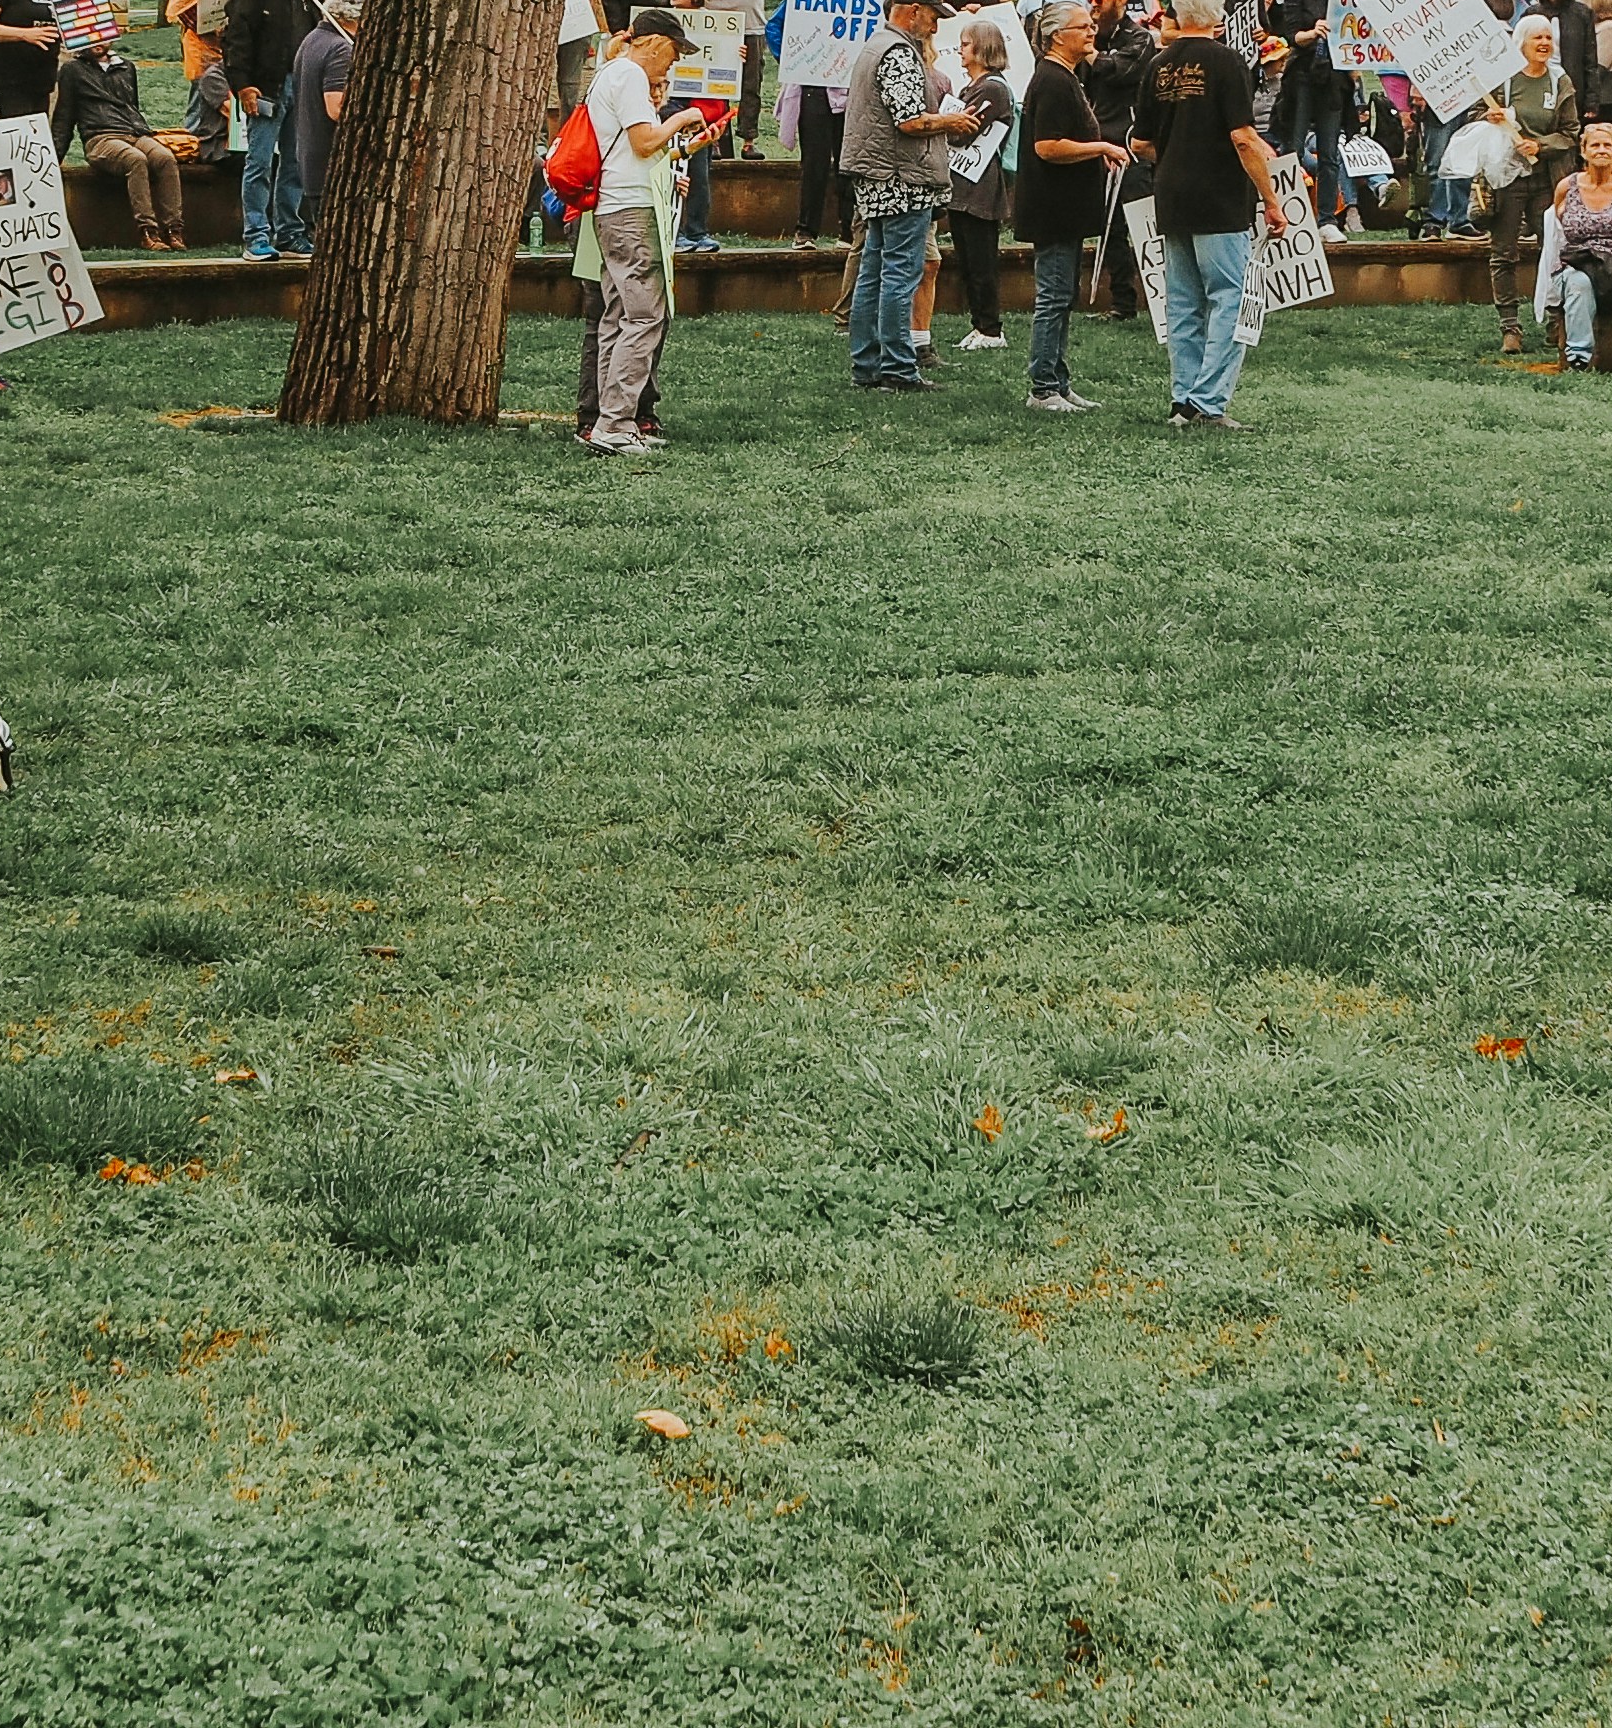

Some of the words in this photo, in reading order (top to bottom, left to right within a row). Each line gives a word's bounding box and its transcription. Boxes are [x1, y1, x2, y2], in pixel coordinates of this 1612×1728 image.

[831, 16, 878, 42] OFF
[1412, 19, 1490, 84] GOVERMENT
[1422, 21, 1447, 47] MY
[1, 128, 58, 188] THESE
[1346, 153, 1388, 168] MUSK
[39, 251, 85, 330] OUD
[1265, 258, 1327, 309] HAN
